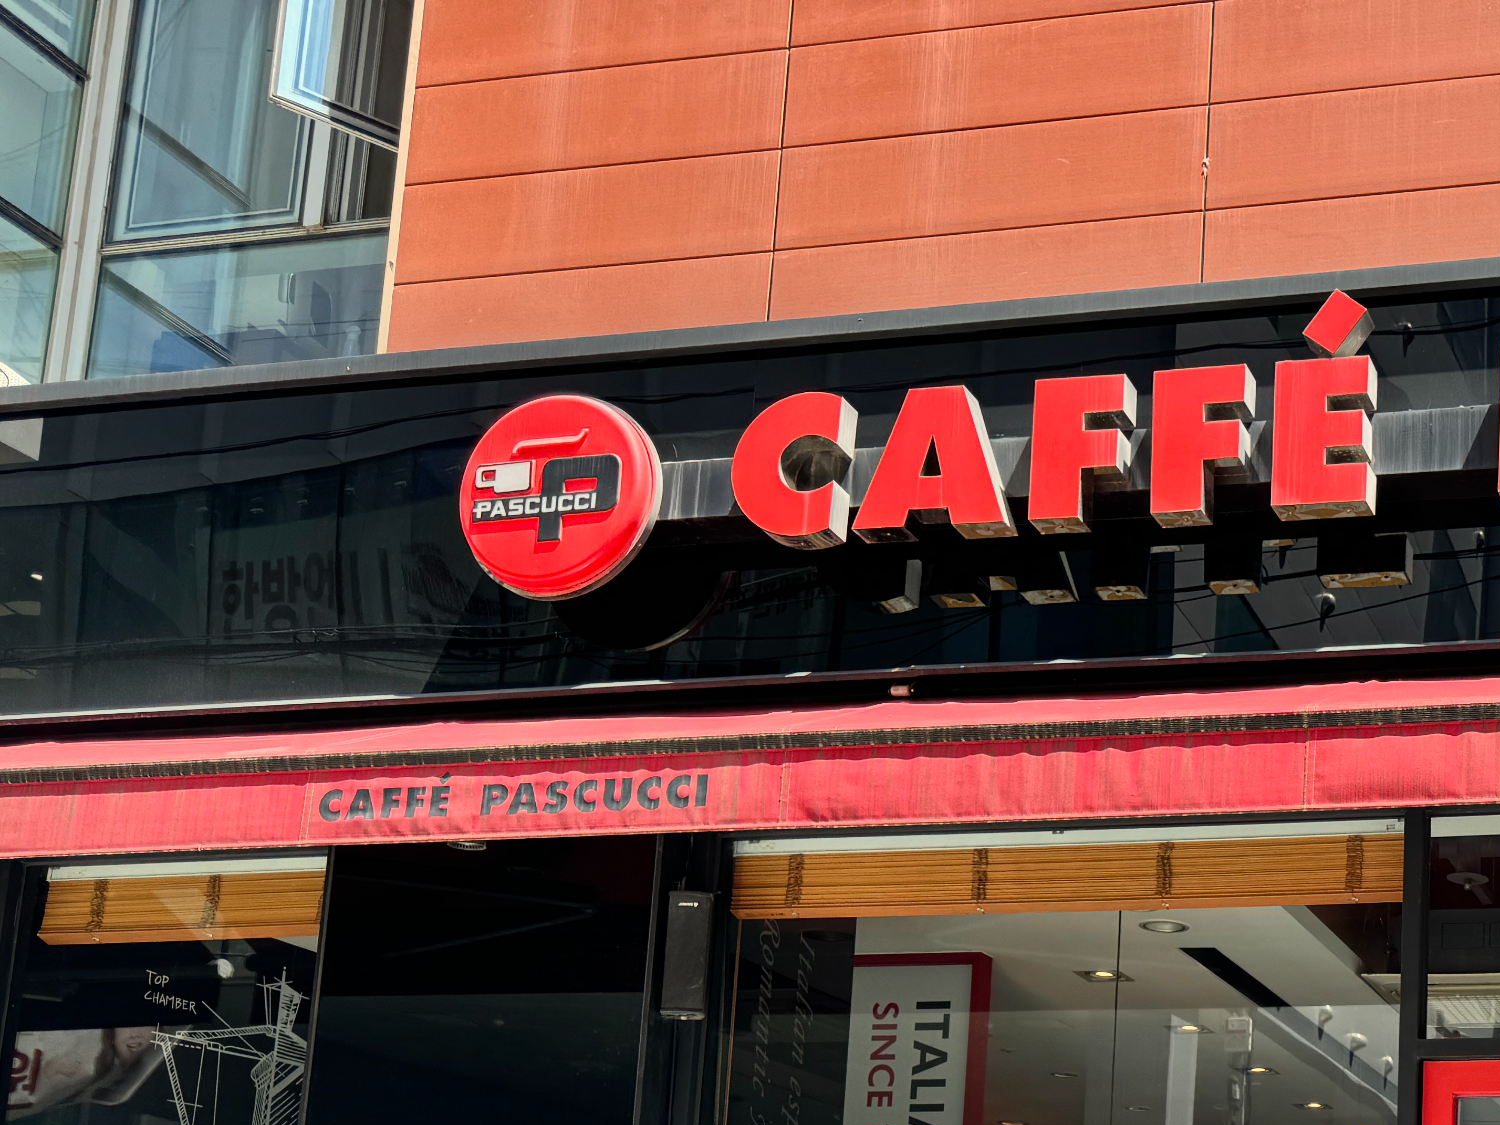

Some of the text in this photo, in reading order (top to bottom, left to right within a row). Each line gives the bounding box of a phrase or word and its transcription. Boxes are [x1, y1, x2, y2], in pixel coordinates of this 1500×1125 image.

[731, 289, 1376, 548] CAFFÉ
[472, 491, 597, 521] PASCUCCI
[318, 771, 709, 822] CAFFÉ PASCUCCI
[144, 990, 197, 1015] CHAMBER
[146, 969, 170, 988] TOP
[751, 919, 781, 1098] Romantic
[790, 931, 817, 1066] Italian
[866, 1002, 899, 1107] SINCE
